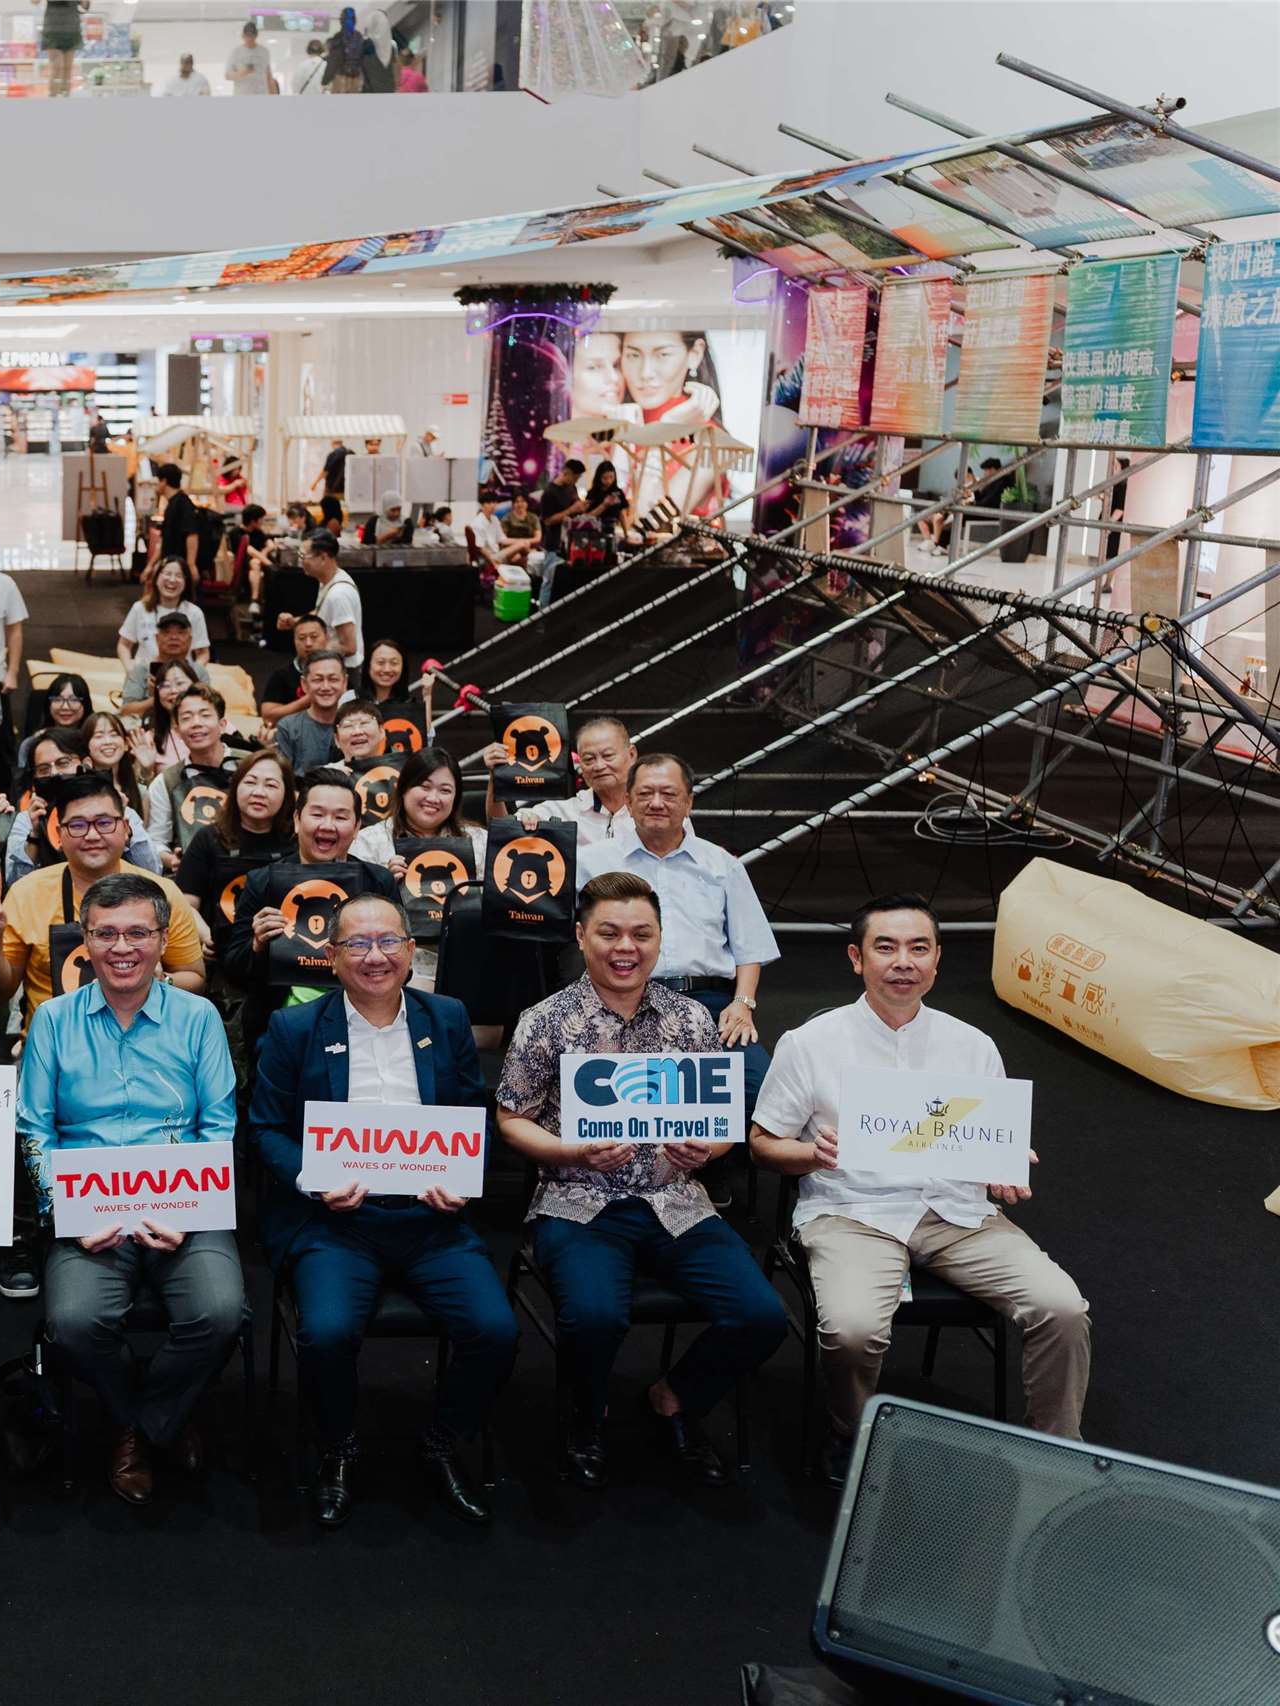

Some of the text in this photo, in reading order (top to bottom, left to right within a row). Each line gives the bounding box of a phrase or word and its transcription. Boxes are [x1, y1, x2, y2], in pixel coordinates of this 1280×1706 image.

[508, 910, 544, 921] Taiwan
[578, 1117, 709, 1138] Come On Travel
[860, 1114, 1014, 1144] ROYAL BRUNEI
[308, 1126, 481, 1158] TAIWAN
[907, 1140, 963, 1152] AIRLINES
[342, 1161, 447, 1173] WAVES OF WONDER
[56, 1166, 230, 1198] TAIWAN
[93, 1200, 199, 1214] WAVES OF WONDER
